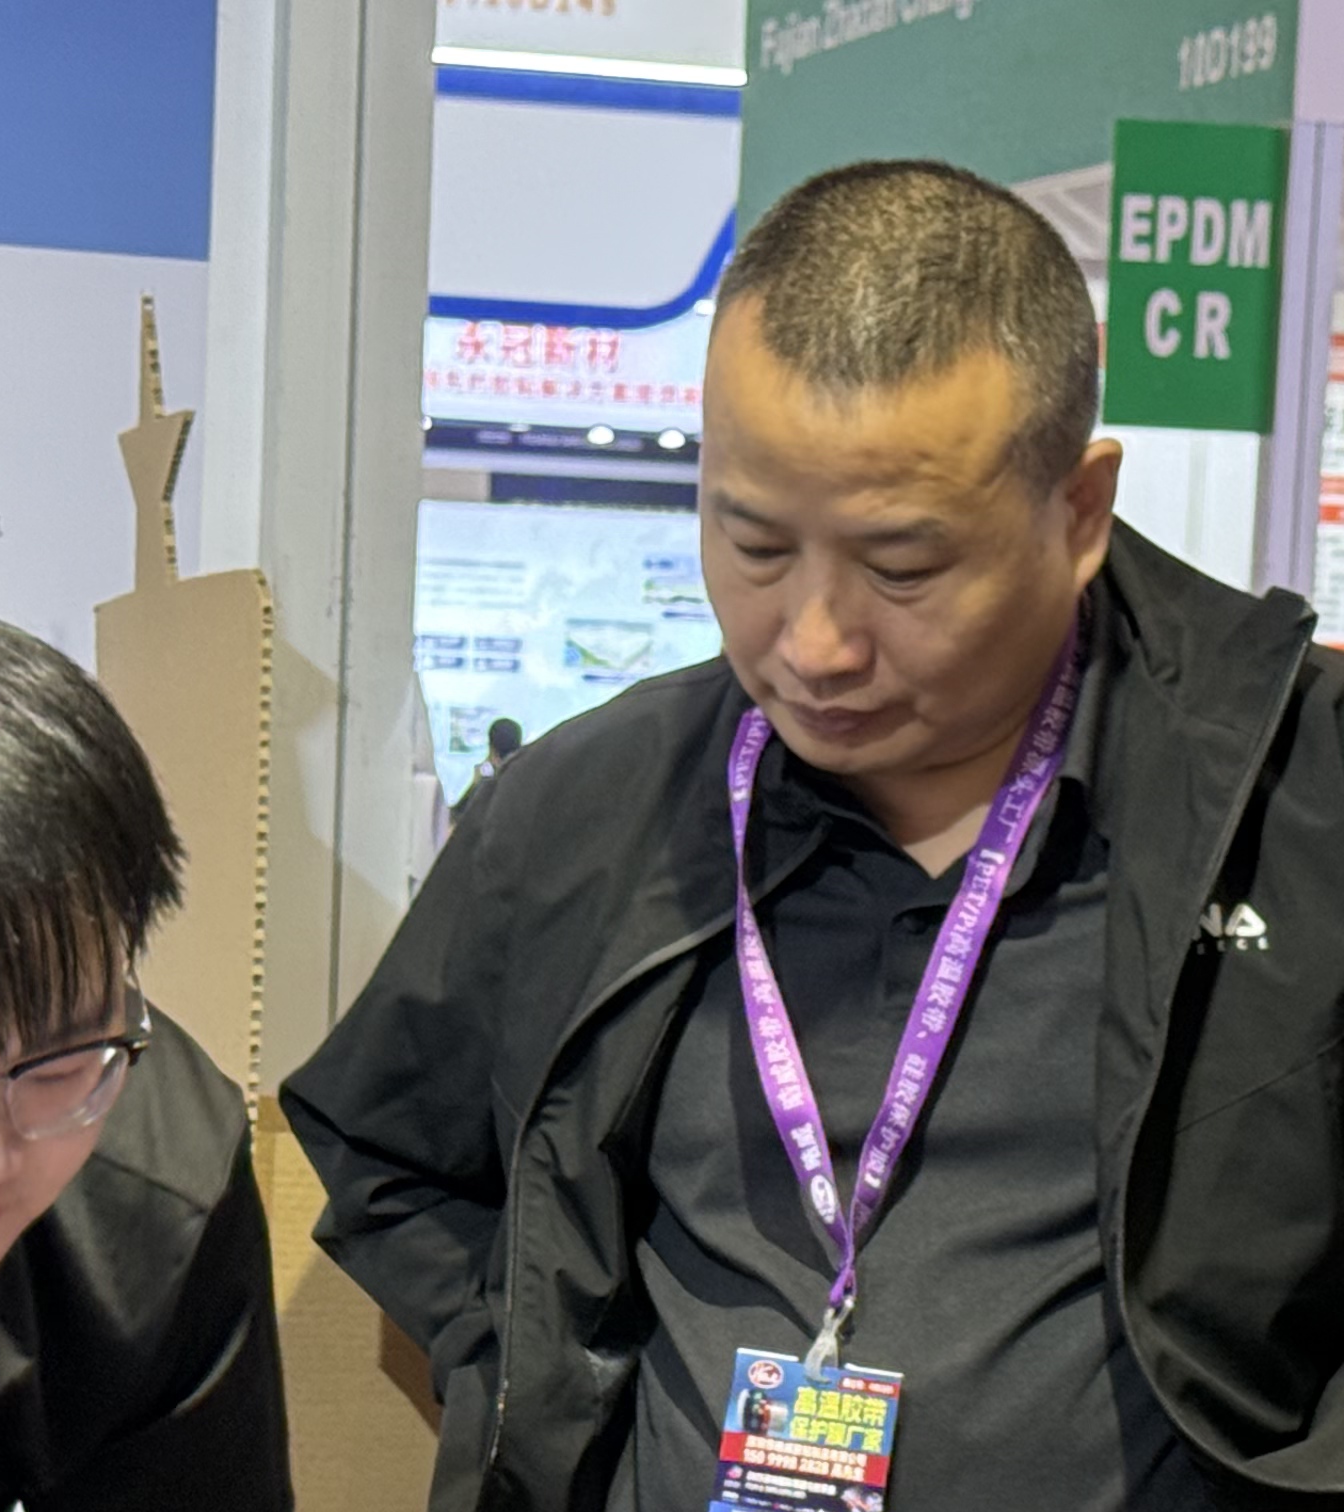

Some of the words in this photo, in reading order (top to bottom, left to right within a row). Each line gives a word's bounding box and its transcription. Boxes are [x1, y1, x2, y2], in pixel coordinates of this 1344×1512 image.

[1118, 193, 1273, 269] EPDM
[793, 1386, 888, 1427] 高温胶带
